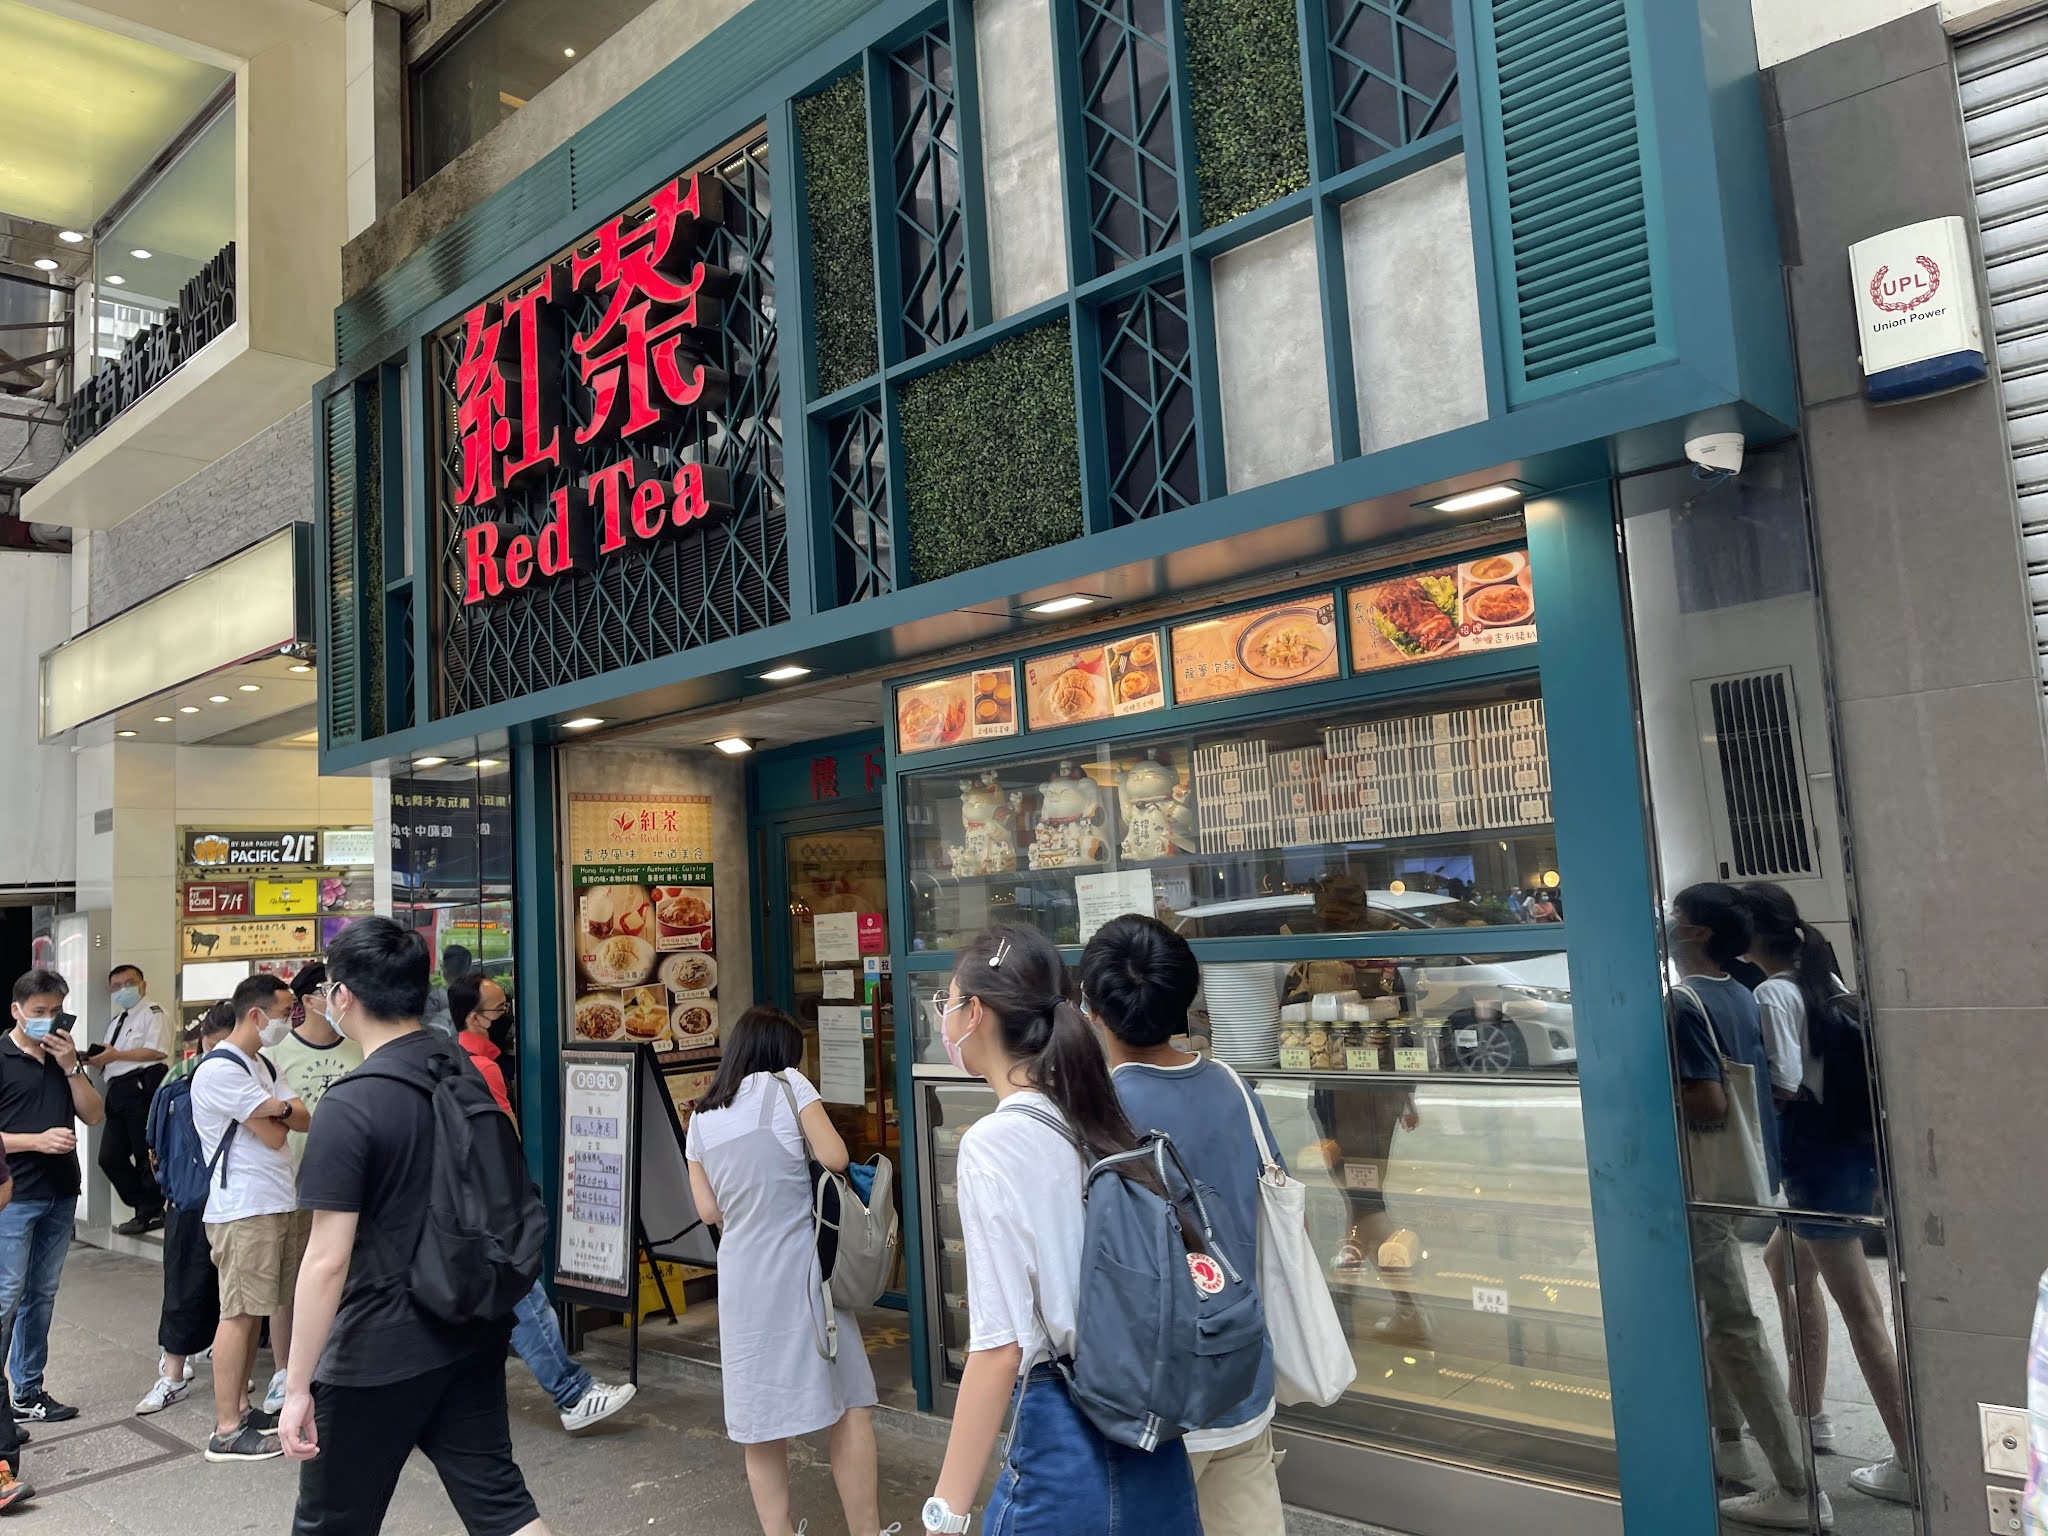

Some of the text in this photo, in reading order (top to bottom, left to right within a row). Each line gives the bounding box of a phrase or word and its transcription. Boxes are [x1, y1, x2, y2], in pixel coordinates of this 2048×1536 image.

[1883, 274, 1927, 296] UPL
[178, 288, 236, 363] METRO
[1873, 307, 1946, 333] Union Power
[455, 173, 706, 508] 紅茶
[70, 316, 175, 444] 旺角新城
[462, 457, 710, 606] Red Tea
[1459, 623, 1483, 635] 招牌
[640, 809, 679, 832] 紅茶
[640, 833, 680, 843] Red Tea
[230, 850, 280, 864] PACIFIC
[281, 834, 315, 863] 2/F
[580, 866, 597, 874] Hong
[599, 866, 615, 874] Kong
[190, 891, 200, 900] FIT
[190, 899, 211, 907] BOXX
[218, 893, 243, 911] 7/f
[860, 927, 882, 935] foodpanda
